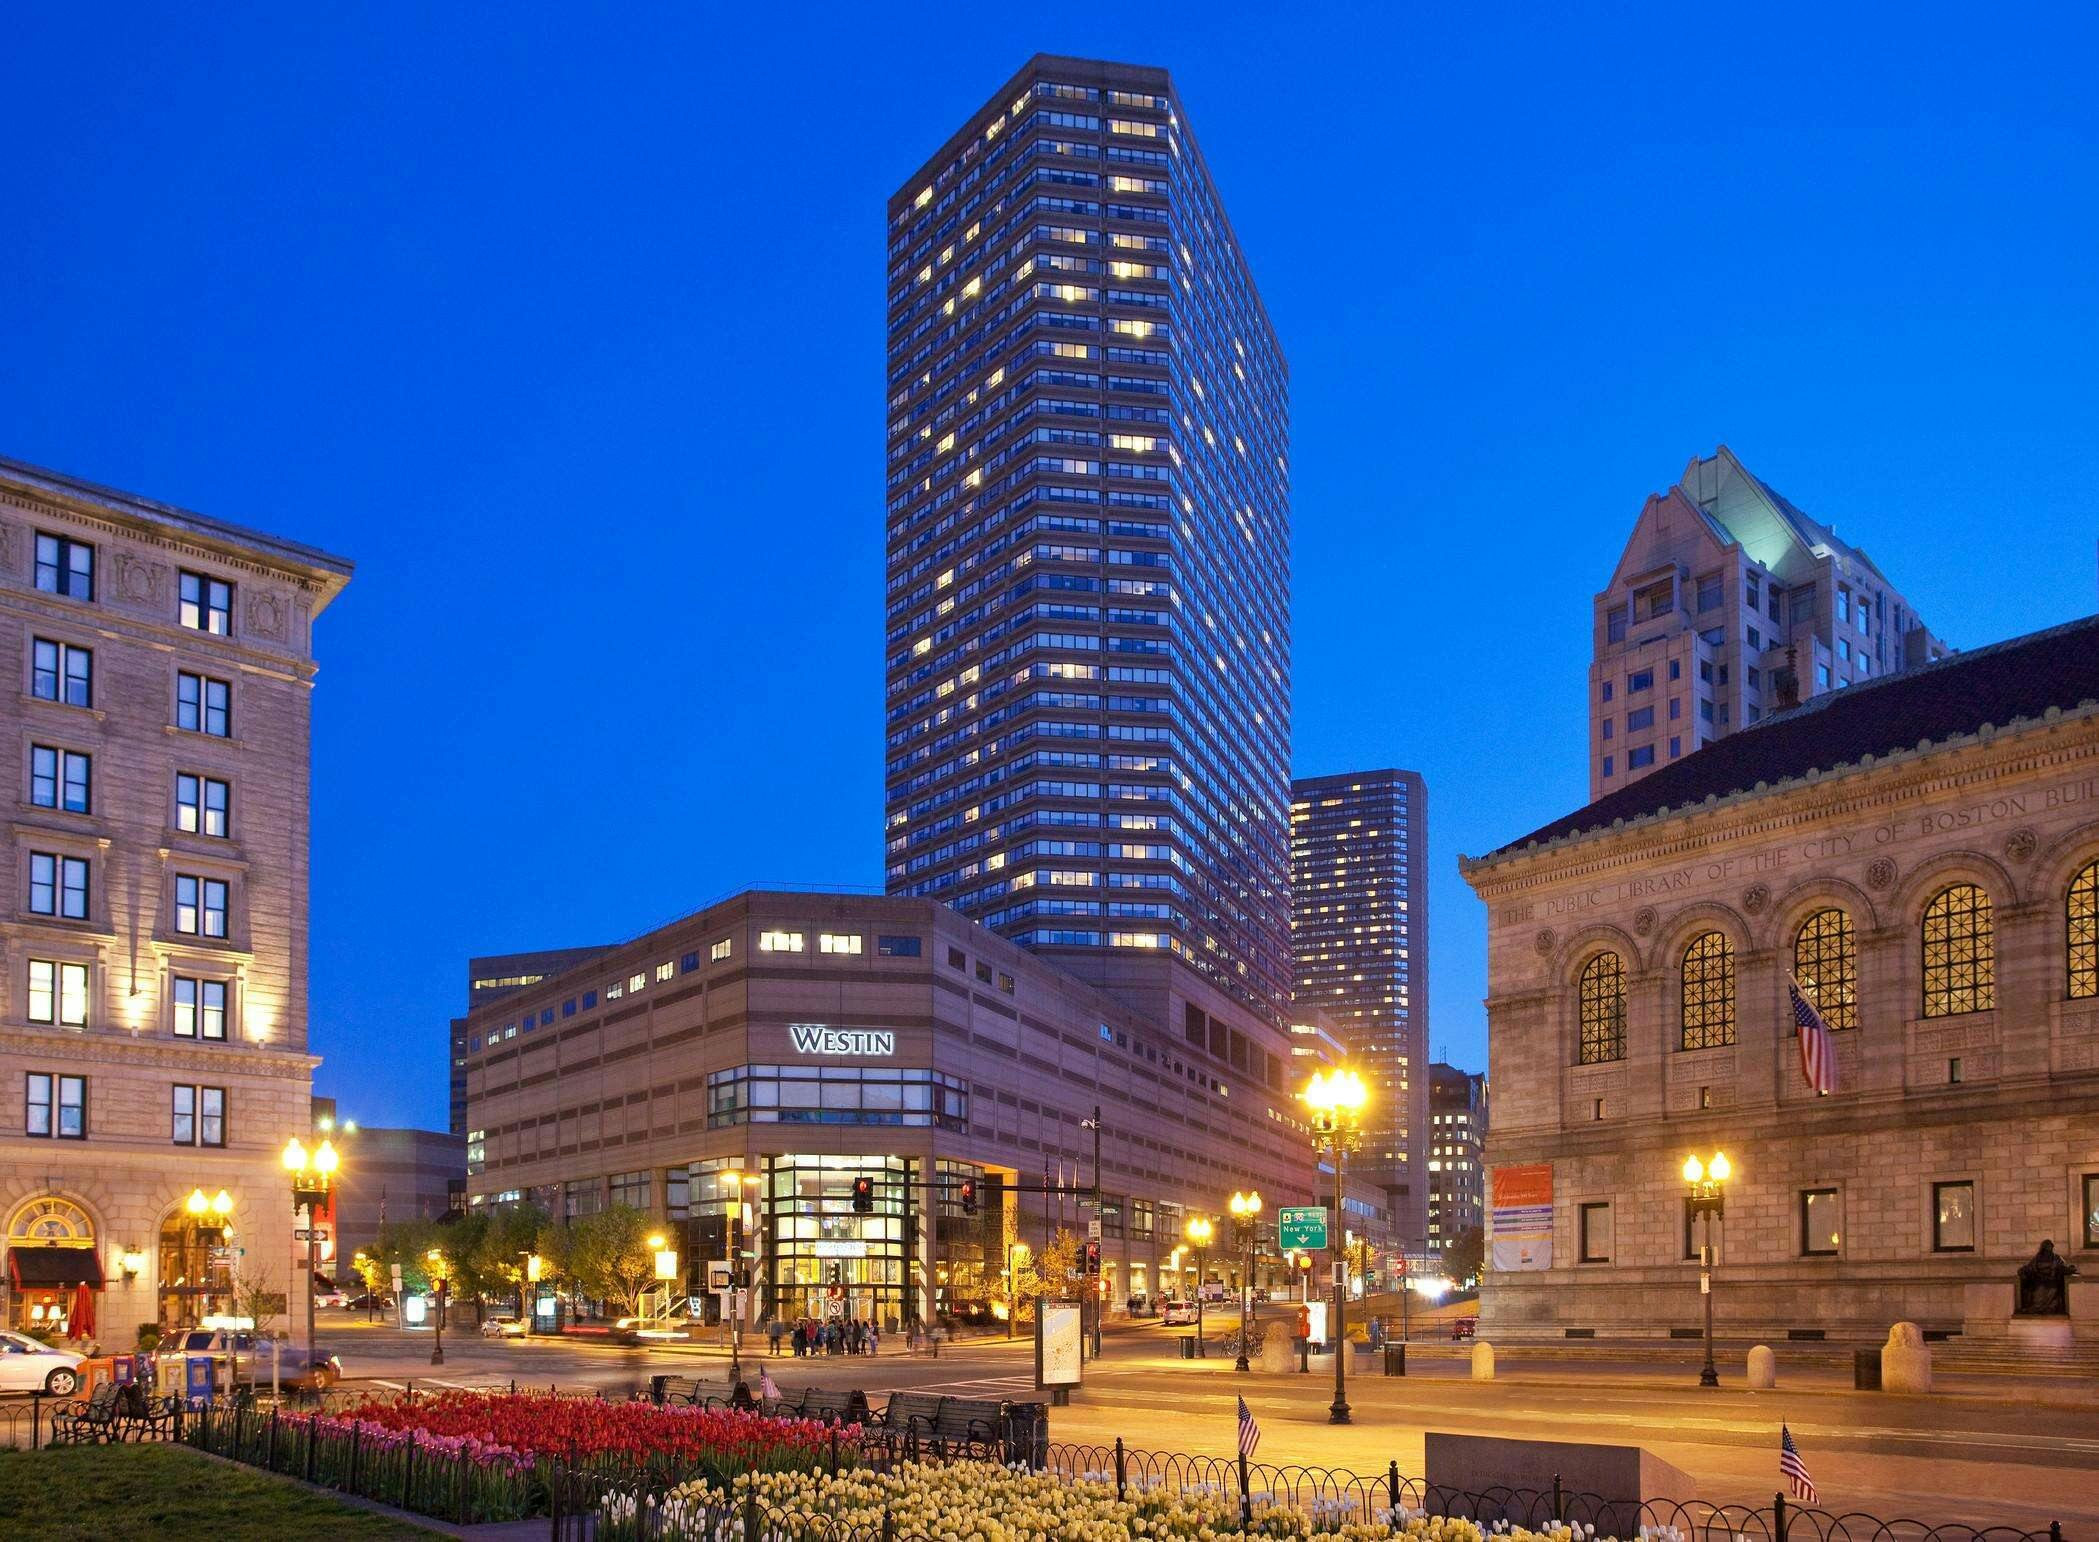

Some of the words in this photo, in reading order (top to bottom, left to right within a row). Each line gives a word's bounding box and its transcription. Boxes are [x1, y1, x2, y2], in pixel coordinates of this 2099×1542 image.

[1504, 905, 1535, 924] THE
[1546, 890, 1601, 916] PUBLIC
[1617, 870, 1695, 901] LIBRARY
[1707, 860, 1734, 880] OF
[1751, 847, 1790, 873] THE
[1803, 832, 1857, 859] CITY
[1875, 822, 1905, 844] OF
[1921, 797, 2027, 835] BOSTON
[2046, 779, 2099, 808] BUIL
[791, 1026, 892, 1053] WESTIN
[1283, 1225, 1301, 1233] New
[1304, 1224, 1323, 1233] York
